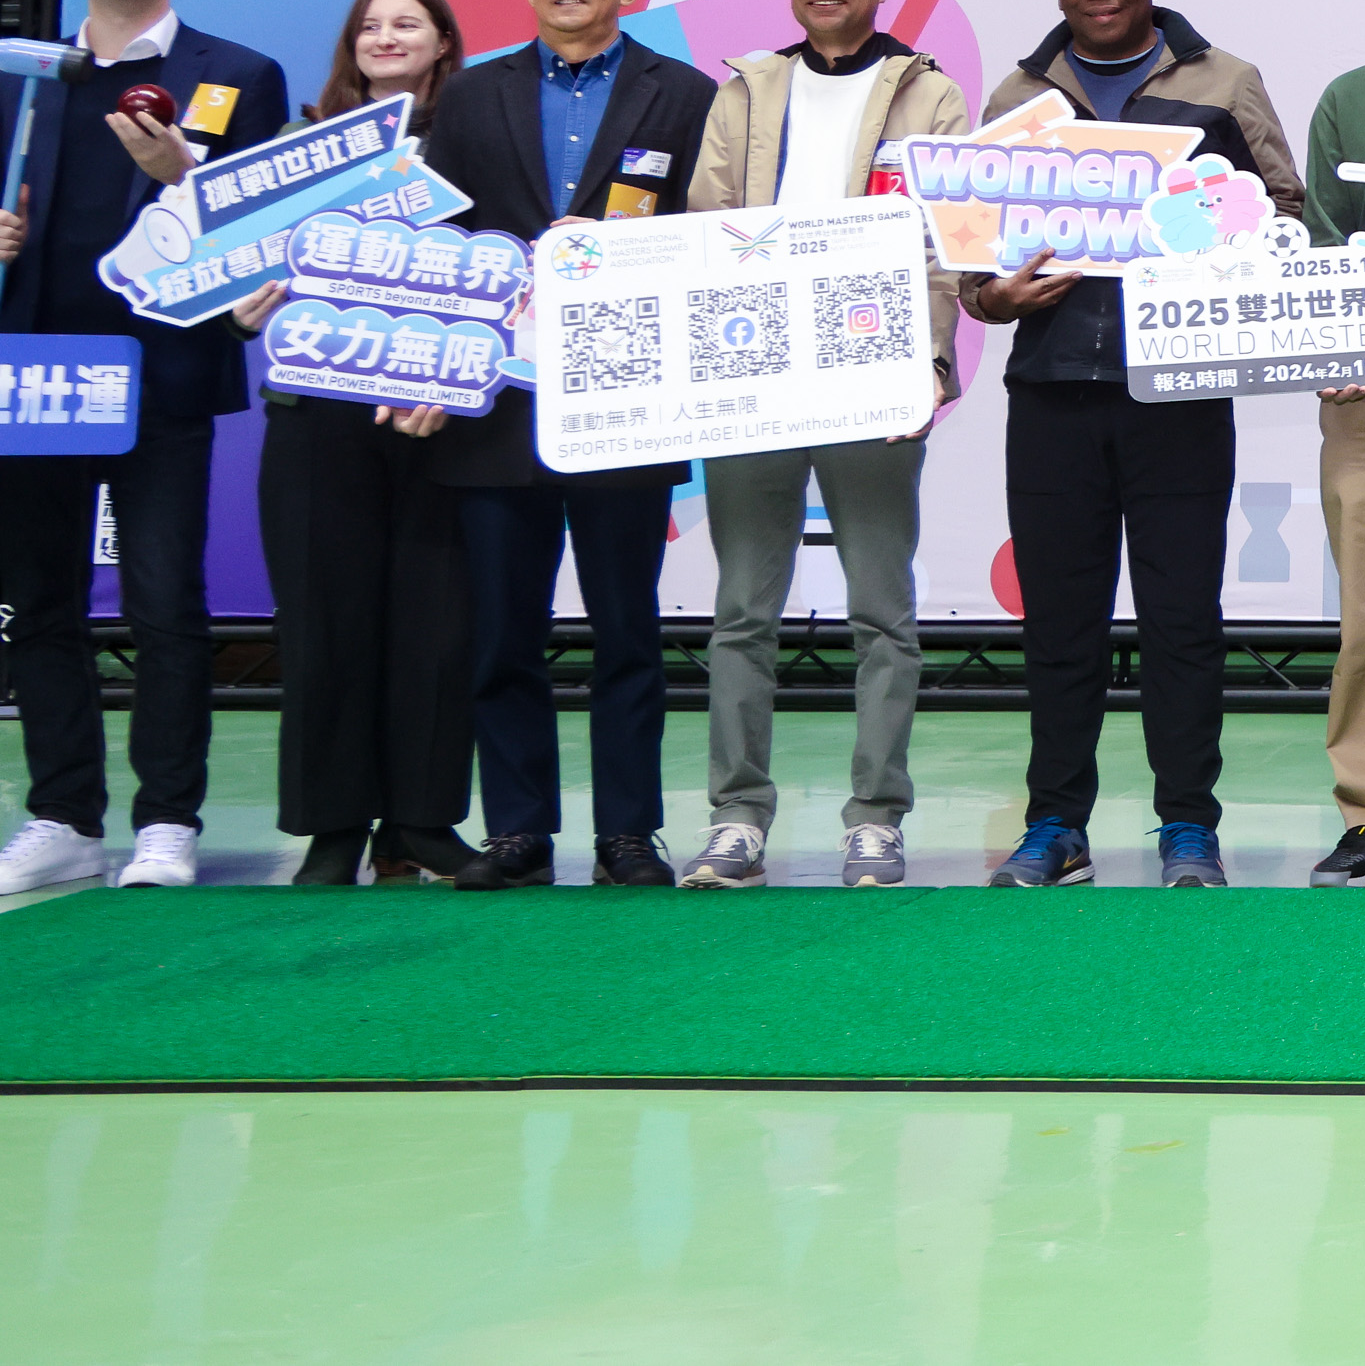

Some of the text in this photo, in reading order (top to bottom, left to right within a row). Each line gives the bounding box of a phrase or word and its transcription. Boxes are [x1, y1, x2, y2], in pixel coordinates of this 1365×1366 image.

[207, 87, 229, 107] 5
[201, 119, 385, 212] 挑戰世壯運
[912, 144, 1155, 200] women
[888, 174, 902, 194] 2
[637, 194, 652, 214] 4
[788, 210, 911, 230] WORLD MASTERS GAMES
[608, 234, 685, 247] INTERNATIONAL
[609, 242, 689, 258] MASTERS GAMES
[789, 239, 829, 256] 2025
[298, 221, 514, 294] 運動無界
[608, 255, 676, 268] ASSOCIATION
[328, 282, 381, 300] SPORTS
[385, 292, 430, 309] beyond
[434, 298, 461, 311] AGE
[1137, 297, 1230, 330] 2025
[275, 311, 494, 384] 女力無限
[1138, 331, 1256, 361] WORLD
[274, 368, 325, 385] WOMEN
[329, 375, 376, 393] POWER
[379, 382, 426, 400] without
[428, 390, 472, 405] LIMITS
[560, 395, 759, 434] 運動無界 人生無限
[557, 405, 916, 459] SPORTS beyond AGE! LIFE without LIMITS!
